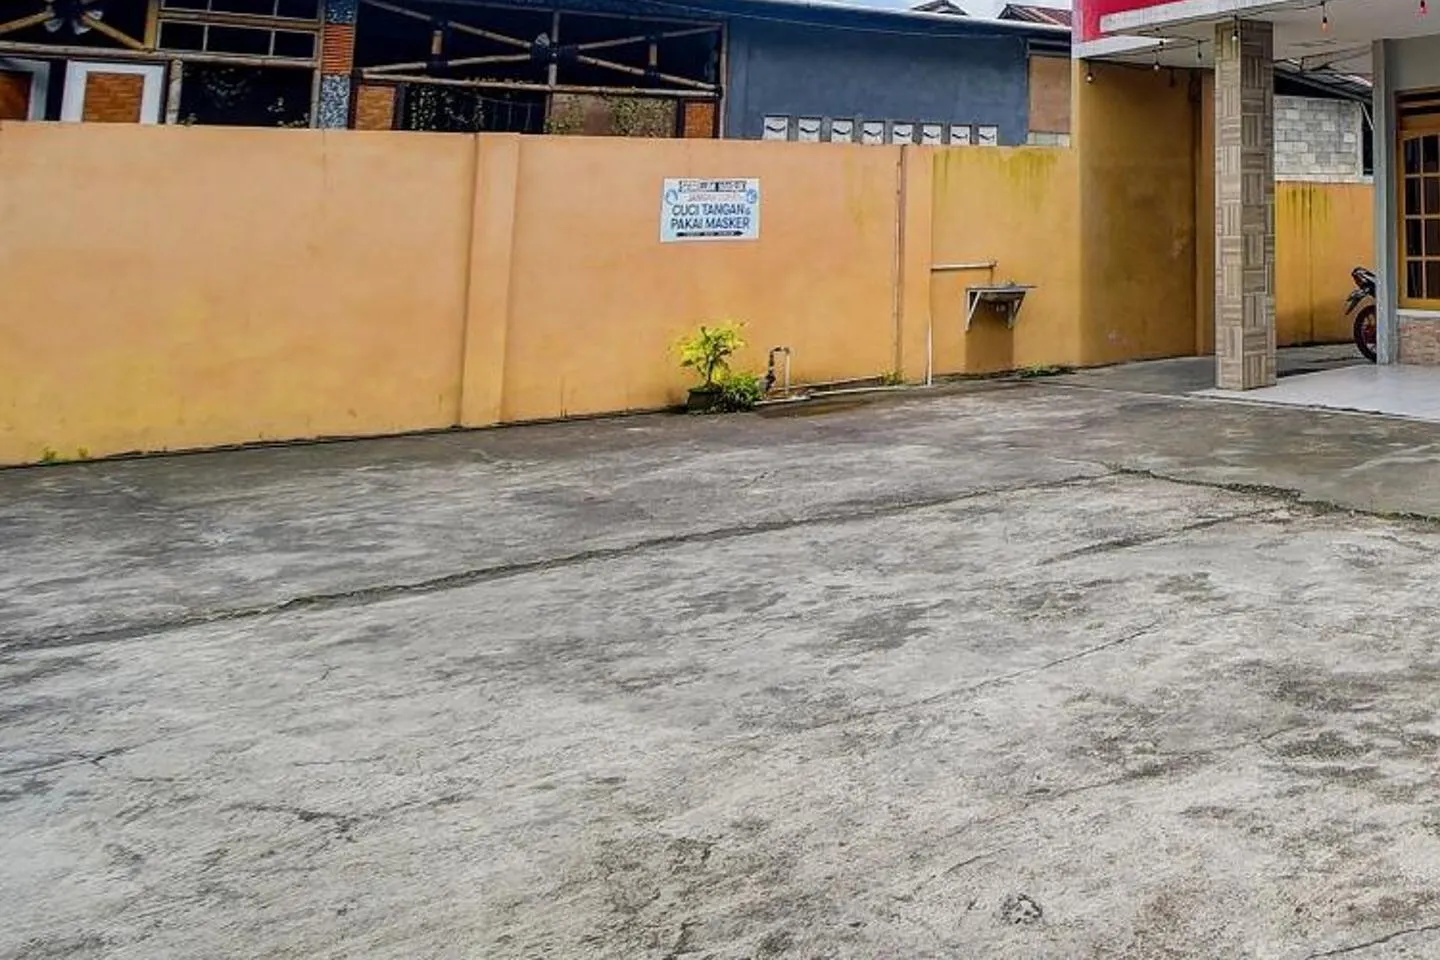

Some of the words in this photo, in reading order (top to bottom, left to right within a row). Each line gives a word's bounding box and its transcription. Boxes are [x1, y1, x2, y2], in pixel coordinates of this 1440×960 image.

[672, 204, 700, 216] CUCI
[702, 203, 745, 215] TANGAN
[671, 218, 703, 229] PAKAI
[706, 217, 750, 229] MASKER
